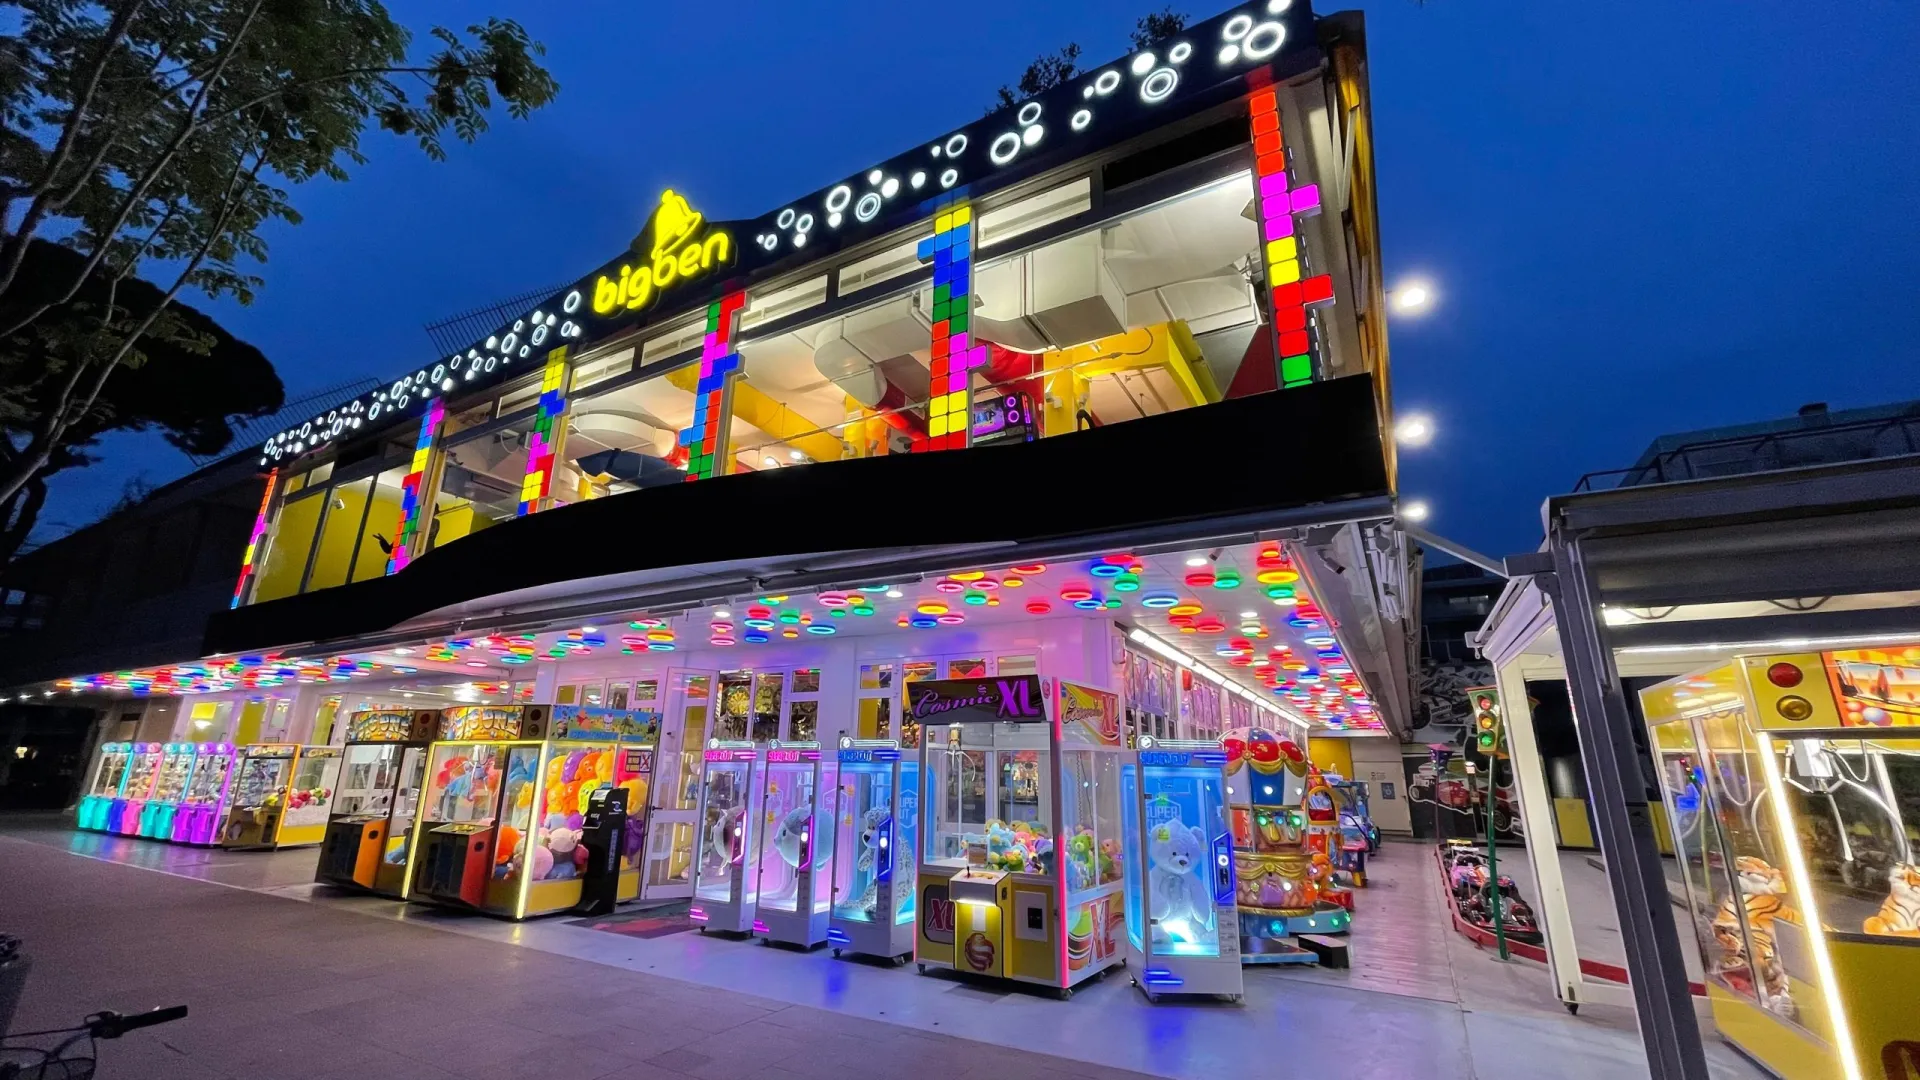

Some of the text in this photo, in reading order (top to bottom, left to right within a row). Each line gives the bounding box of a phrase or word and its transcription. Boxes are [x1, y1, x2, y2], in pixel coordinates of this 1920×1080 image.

[914, 679, 1041, 718] Cosmic XL
[1101, 694, 1119, 734] XL
[1088, 896, 1116, 968] XL
